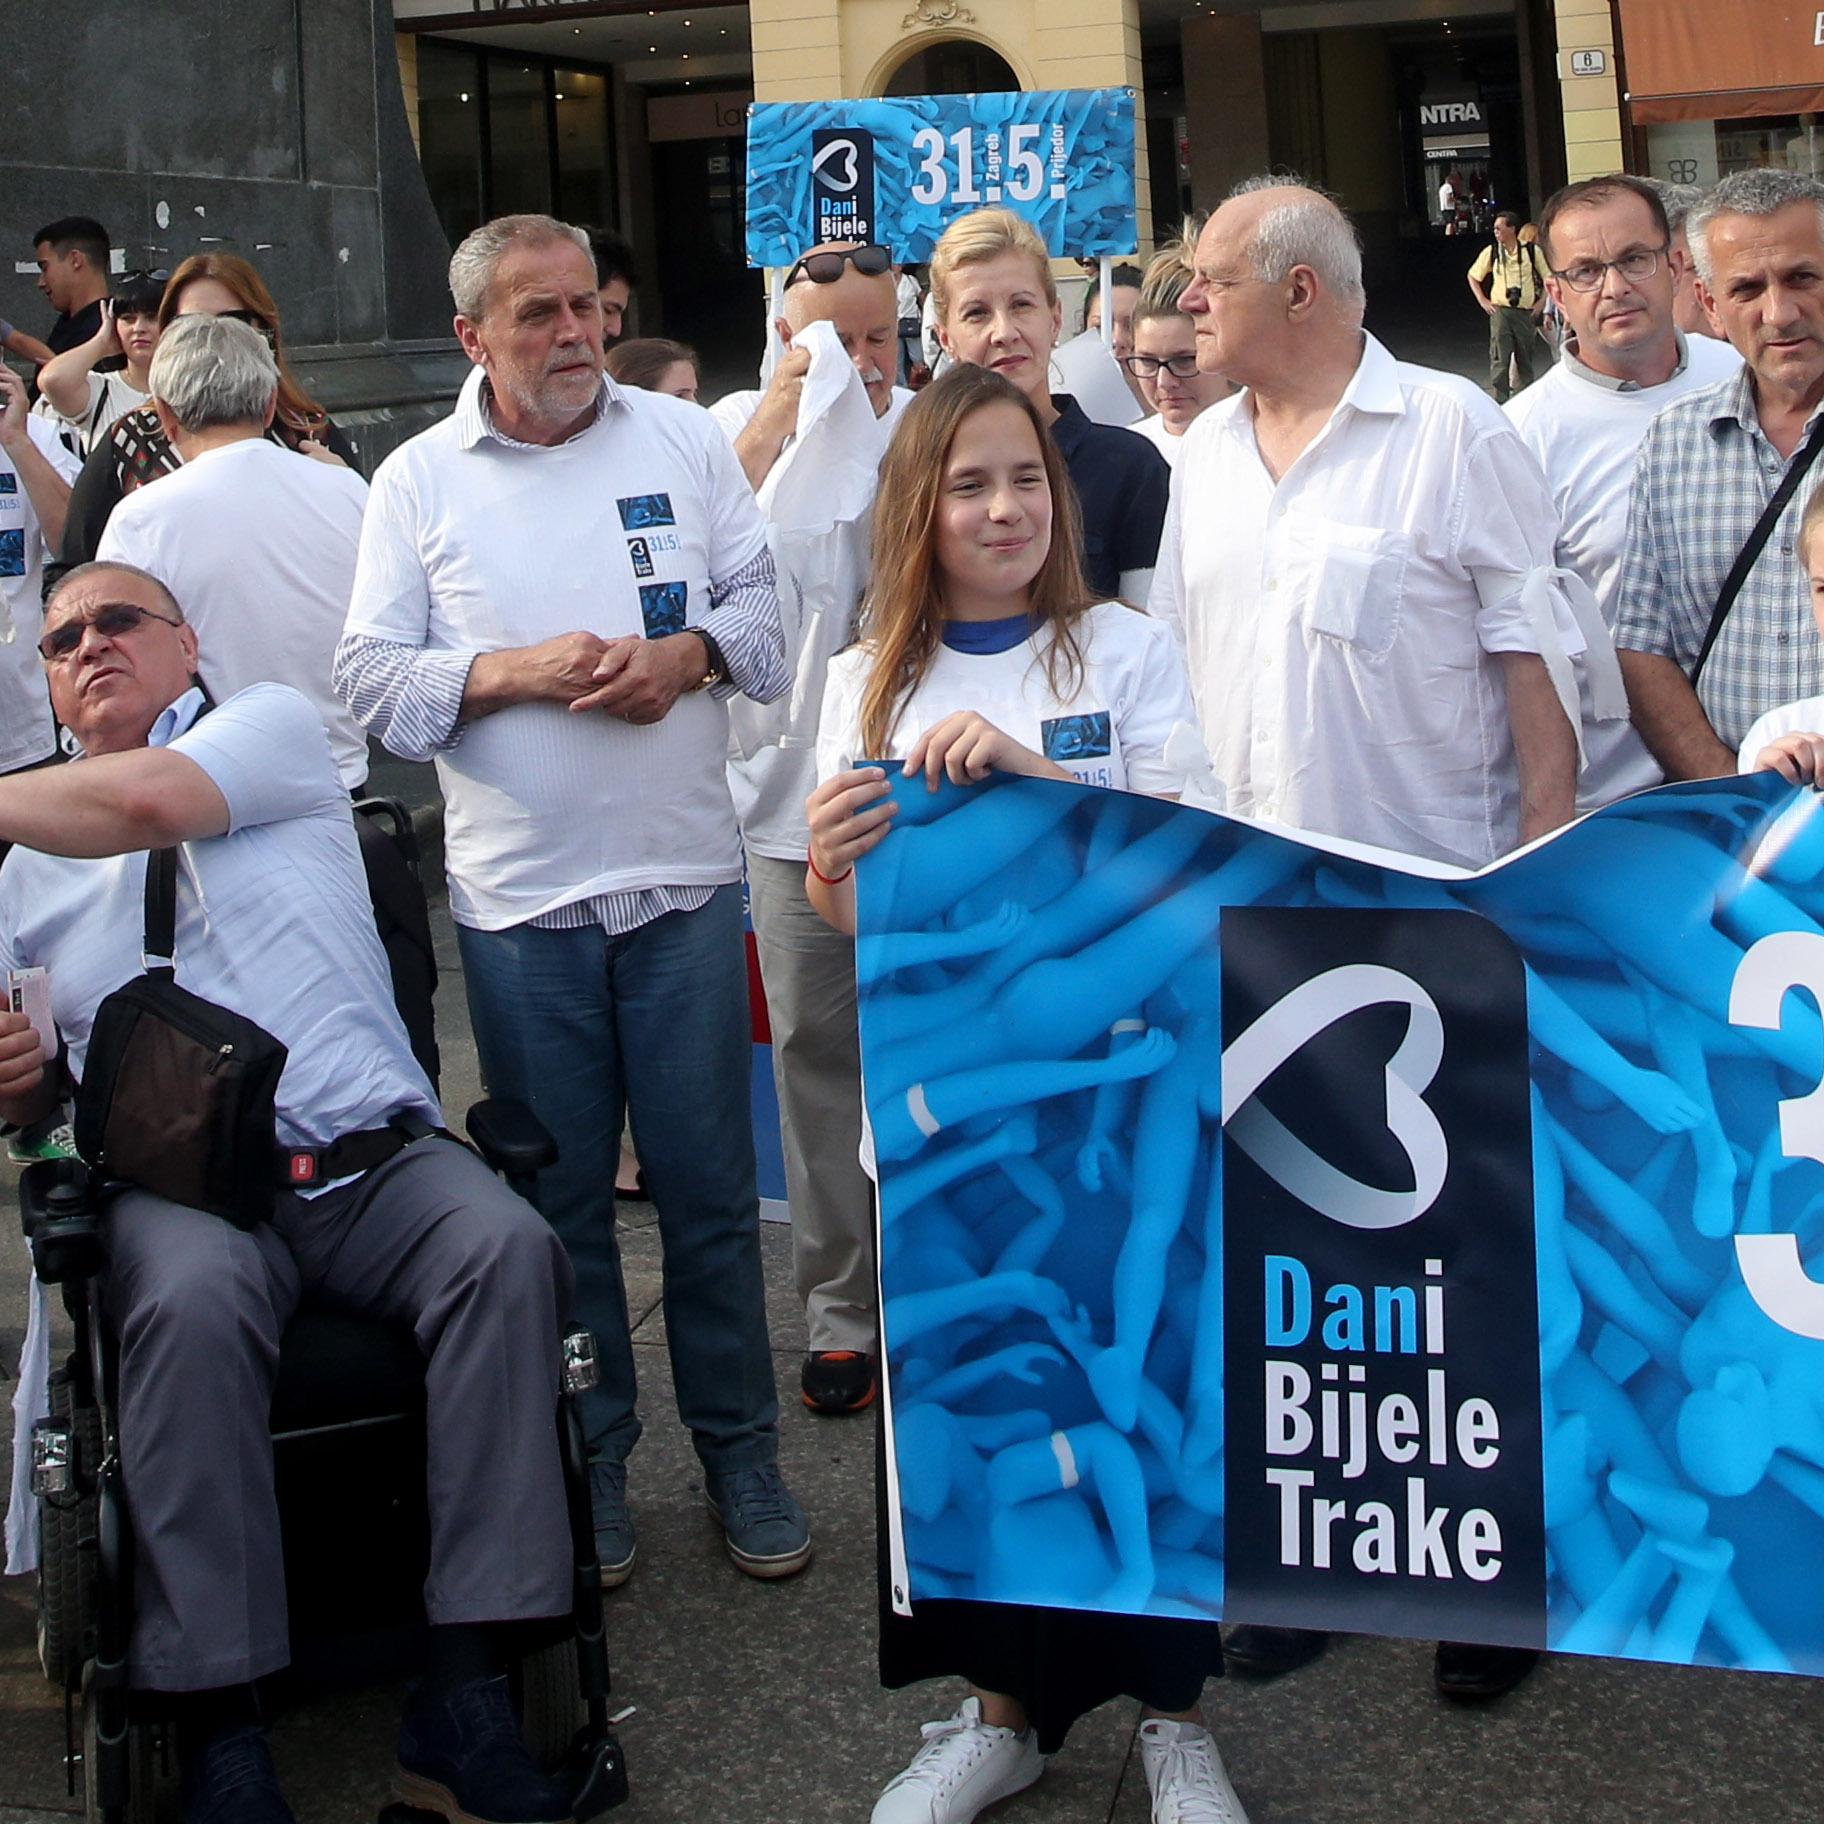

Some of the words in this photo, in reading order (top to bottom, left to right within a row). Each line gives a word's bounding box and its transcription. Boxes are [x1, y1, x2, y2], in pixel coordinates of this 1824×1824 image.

[1583, 52, 1592, 66] 6
[986, 133, 1002, 181] Zagreb
[1050, 123, 1065, 179] Prijedor
[821, 195, 857, 215] Dani
[821, 216, 867, 238] Bijele
[1264, 1254, 1444, 1355] Dani
[1265, 1360, 1501, 1479] Bijele
[1266, 1469, 1503, 1582] Trake
